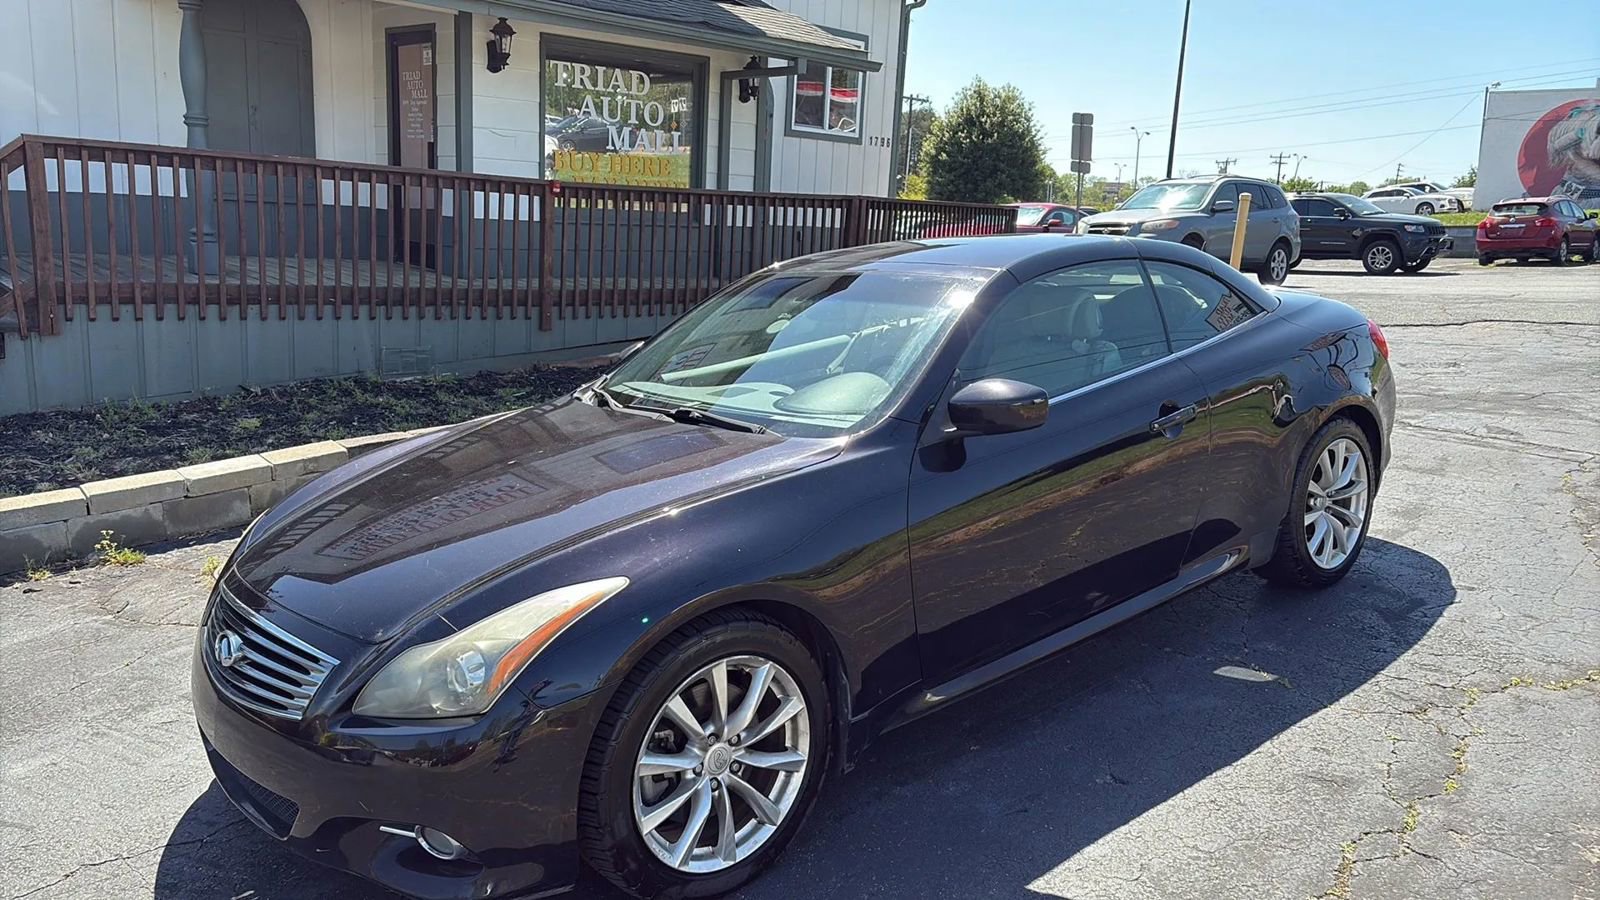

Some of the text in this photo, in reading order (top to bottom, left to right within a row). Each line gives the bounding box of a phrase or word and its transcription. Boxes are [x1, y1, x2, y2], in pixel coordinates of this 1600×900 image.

[402, 71, 421, 80] TRIAD
[549, 60, 650, 95] TRIAD
[406, 81, 424, 90] AUTO
[411, 89, 428, 98] MALL
[577, 95, 664, 127] AUTO
[606, 125, 681, 154] MALL
[869, 136, 891, 148] 1796
[554, 151, 671, 177] BUY HERE
